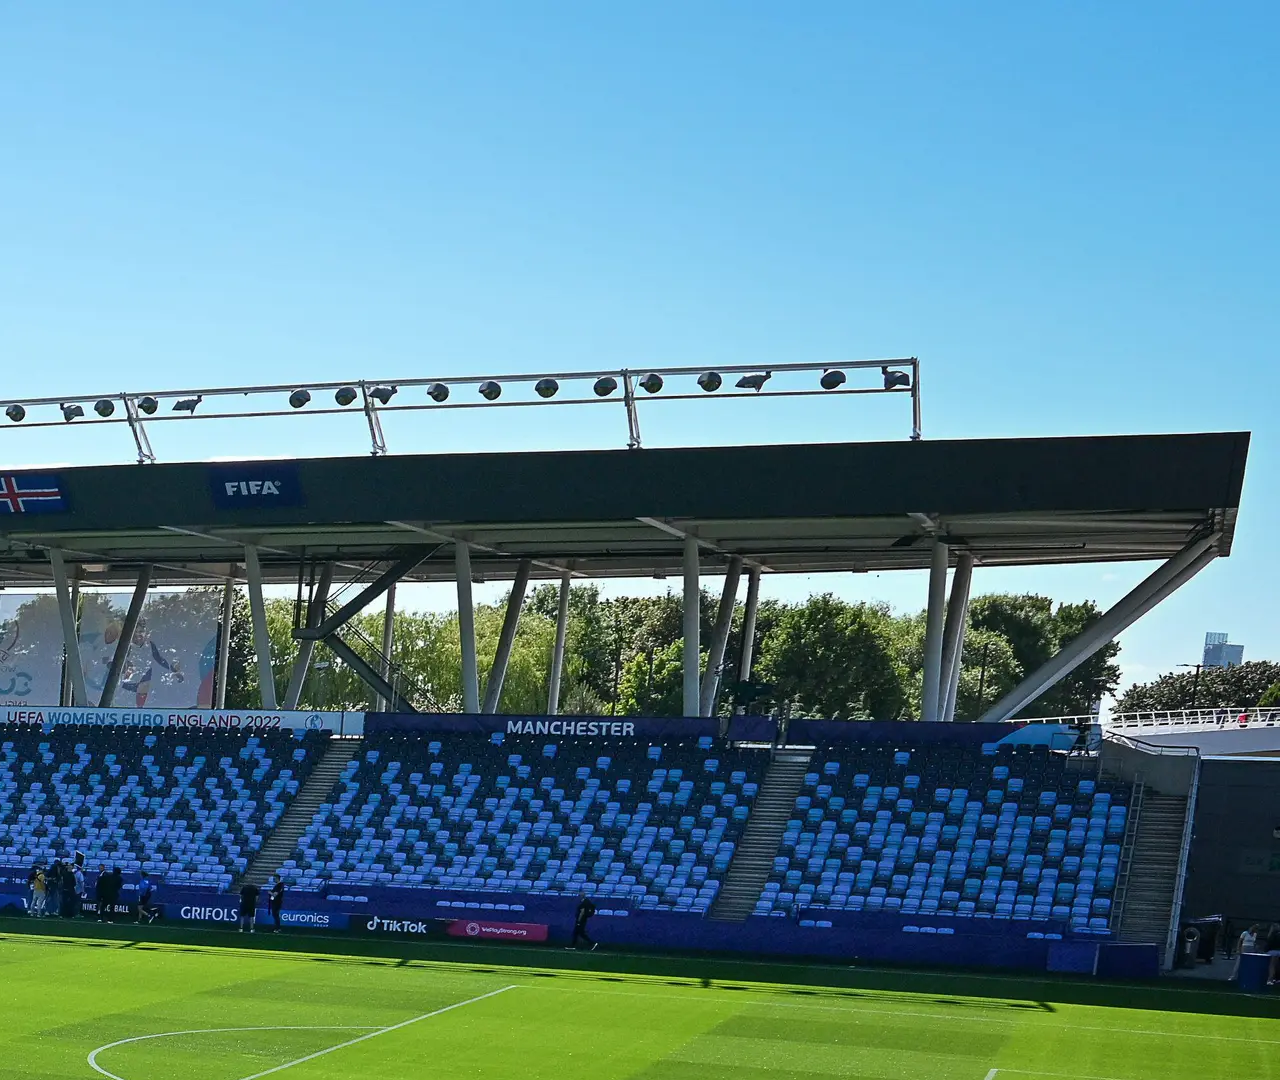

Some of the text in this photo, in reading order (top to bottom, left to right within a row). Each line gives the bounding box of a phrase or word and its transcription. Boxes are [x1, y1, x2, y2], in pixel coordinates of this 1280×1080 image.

[7, 711, 281, 728] UEFA WOMEN'S EURO ENGLAND 2022
[506, 720, 634, 736] MANCHESTER
[82, 903, 97, 912] NIKE
[114, 905, 129, 913] BALL
[180, 906, 238, 922] GRIFOLS
[281, 912, 329, 924] euronics
[382, 919, 427, 934] TikTok
